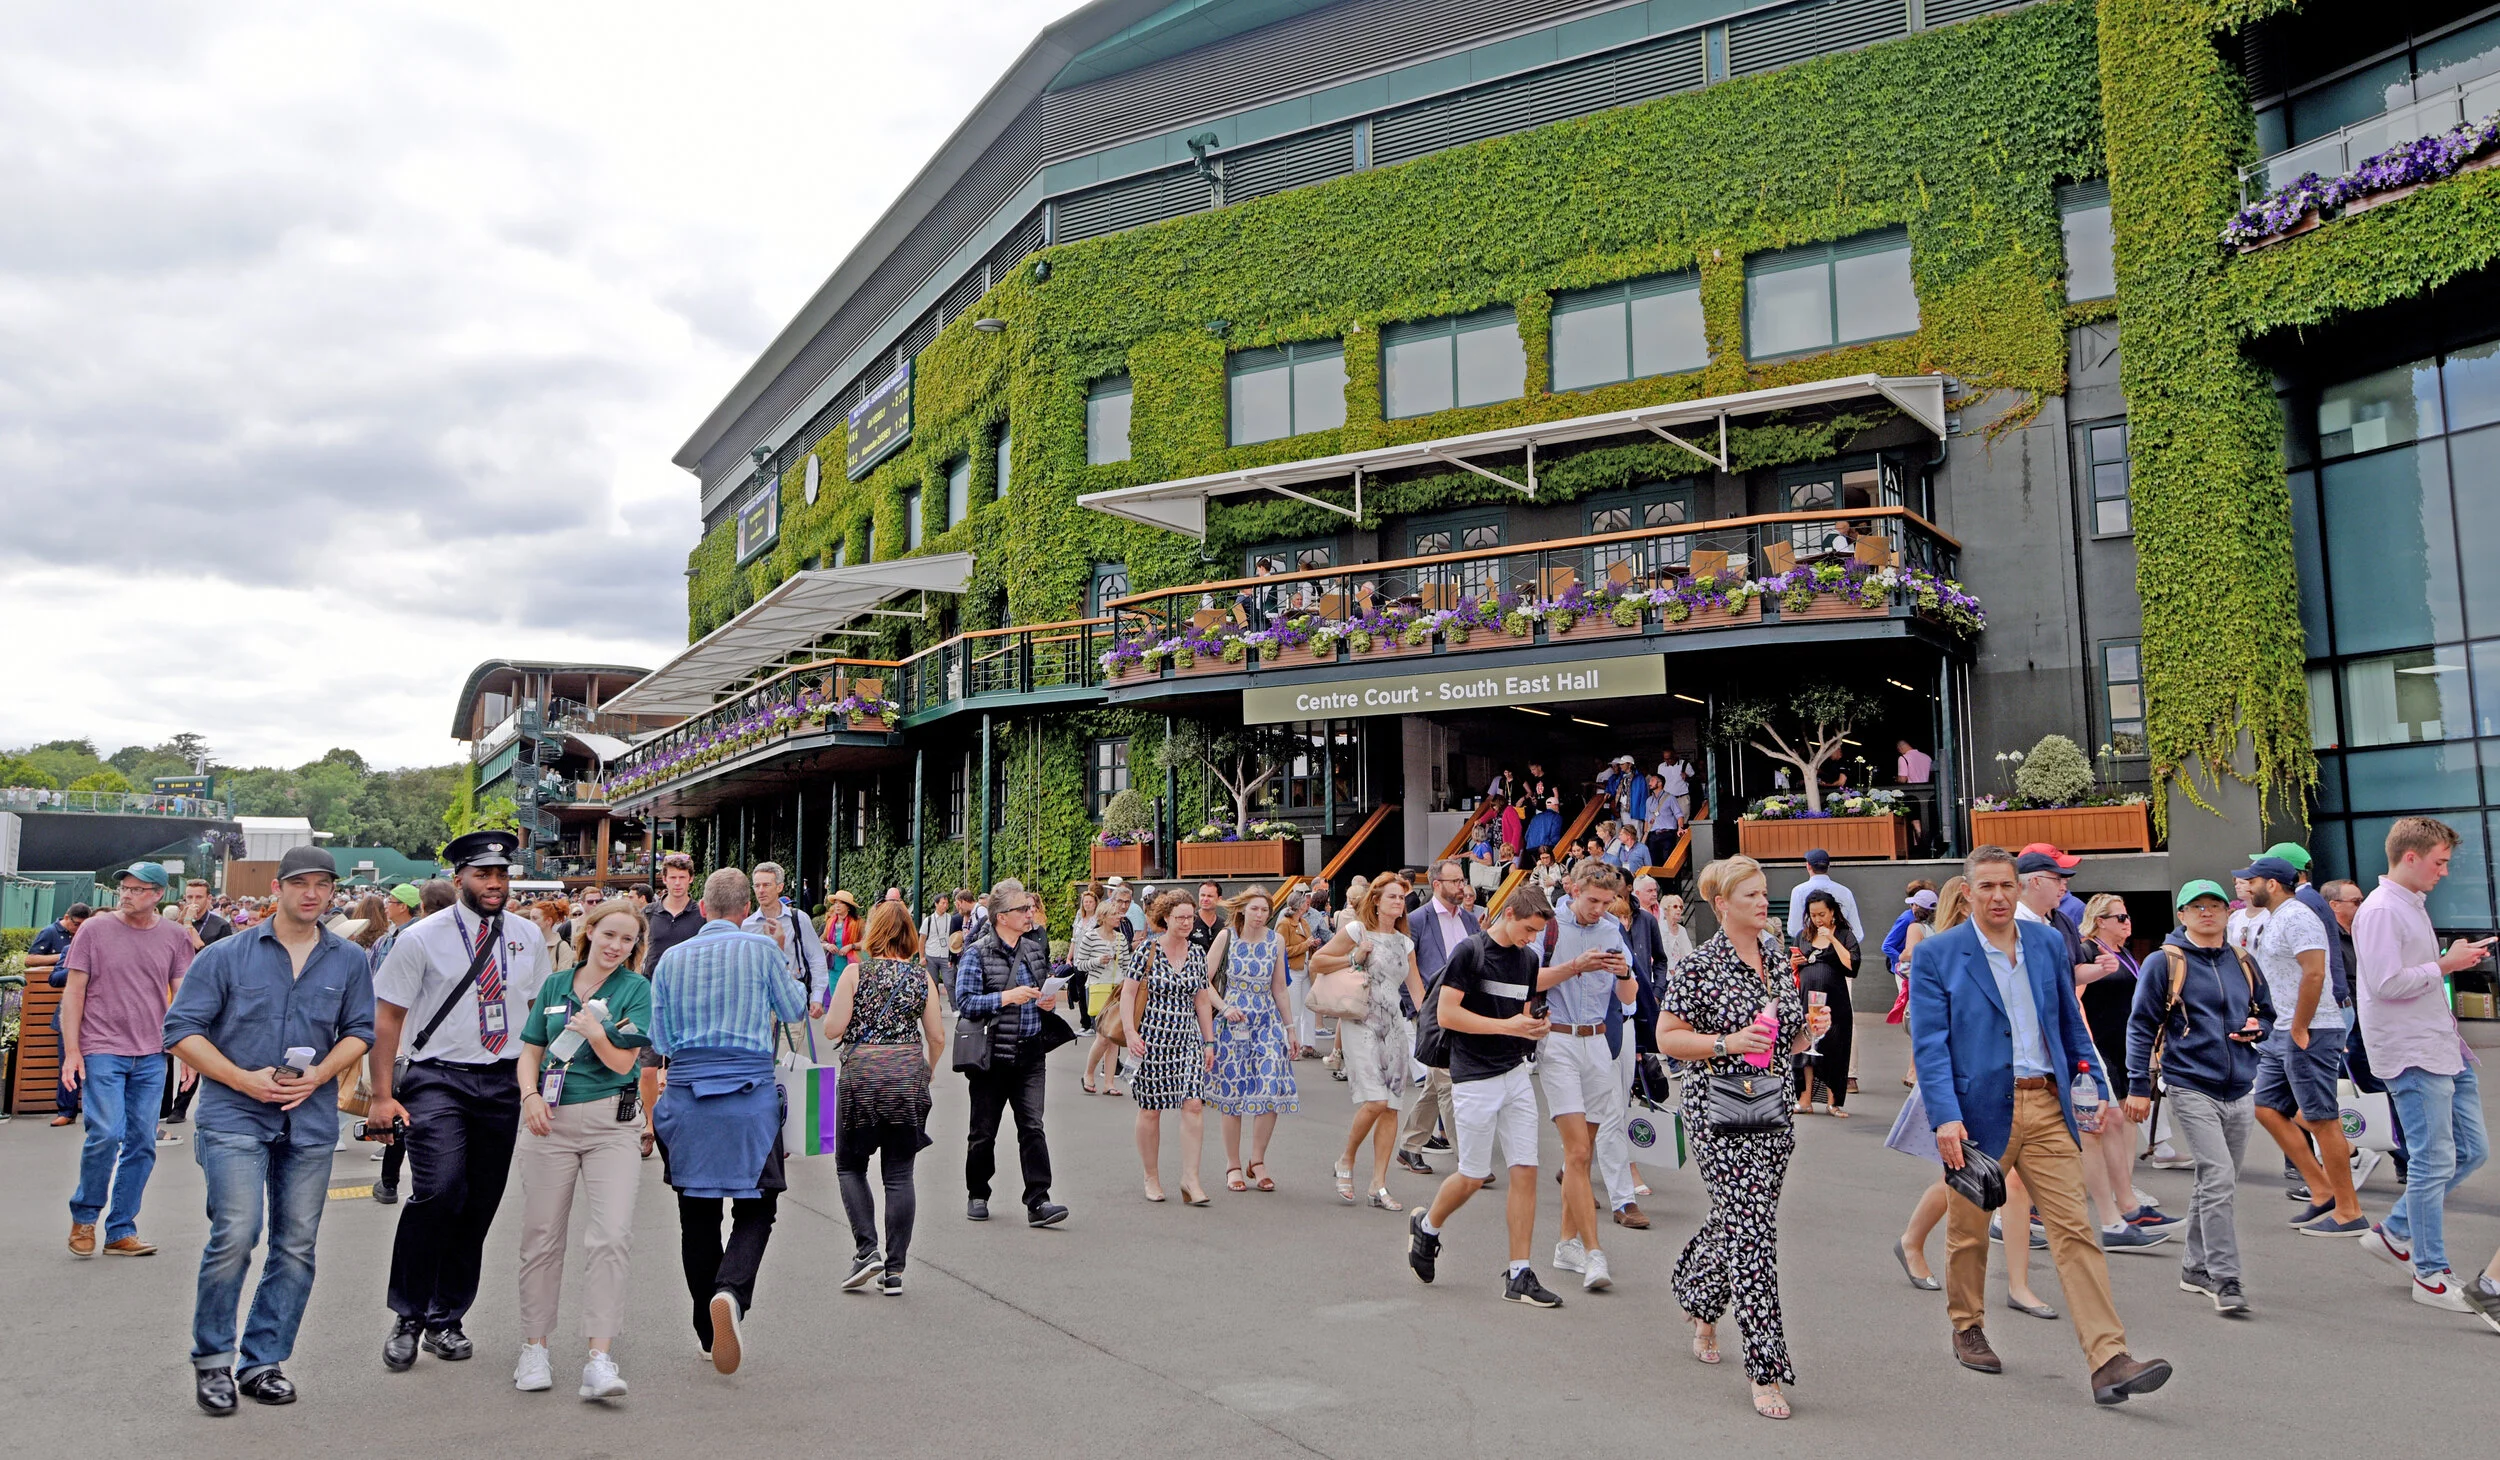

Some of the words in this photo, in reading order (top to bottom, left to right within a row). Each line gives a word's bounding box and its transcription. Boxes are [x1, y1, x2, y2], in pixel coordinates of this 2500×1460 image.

[1296, 692, 1359, 712] Centre
[1364, 685, 1419, 706] Court
[1439, 678, 1499, 701] South
[1505, 675, 1551, 695] East
[1557, 669, 1599, 691] Hall
